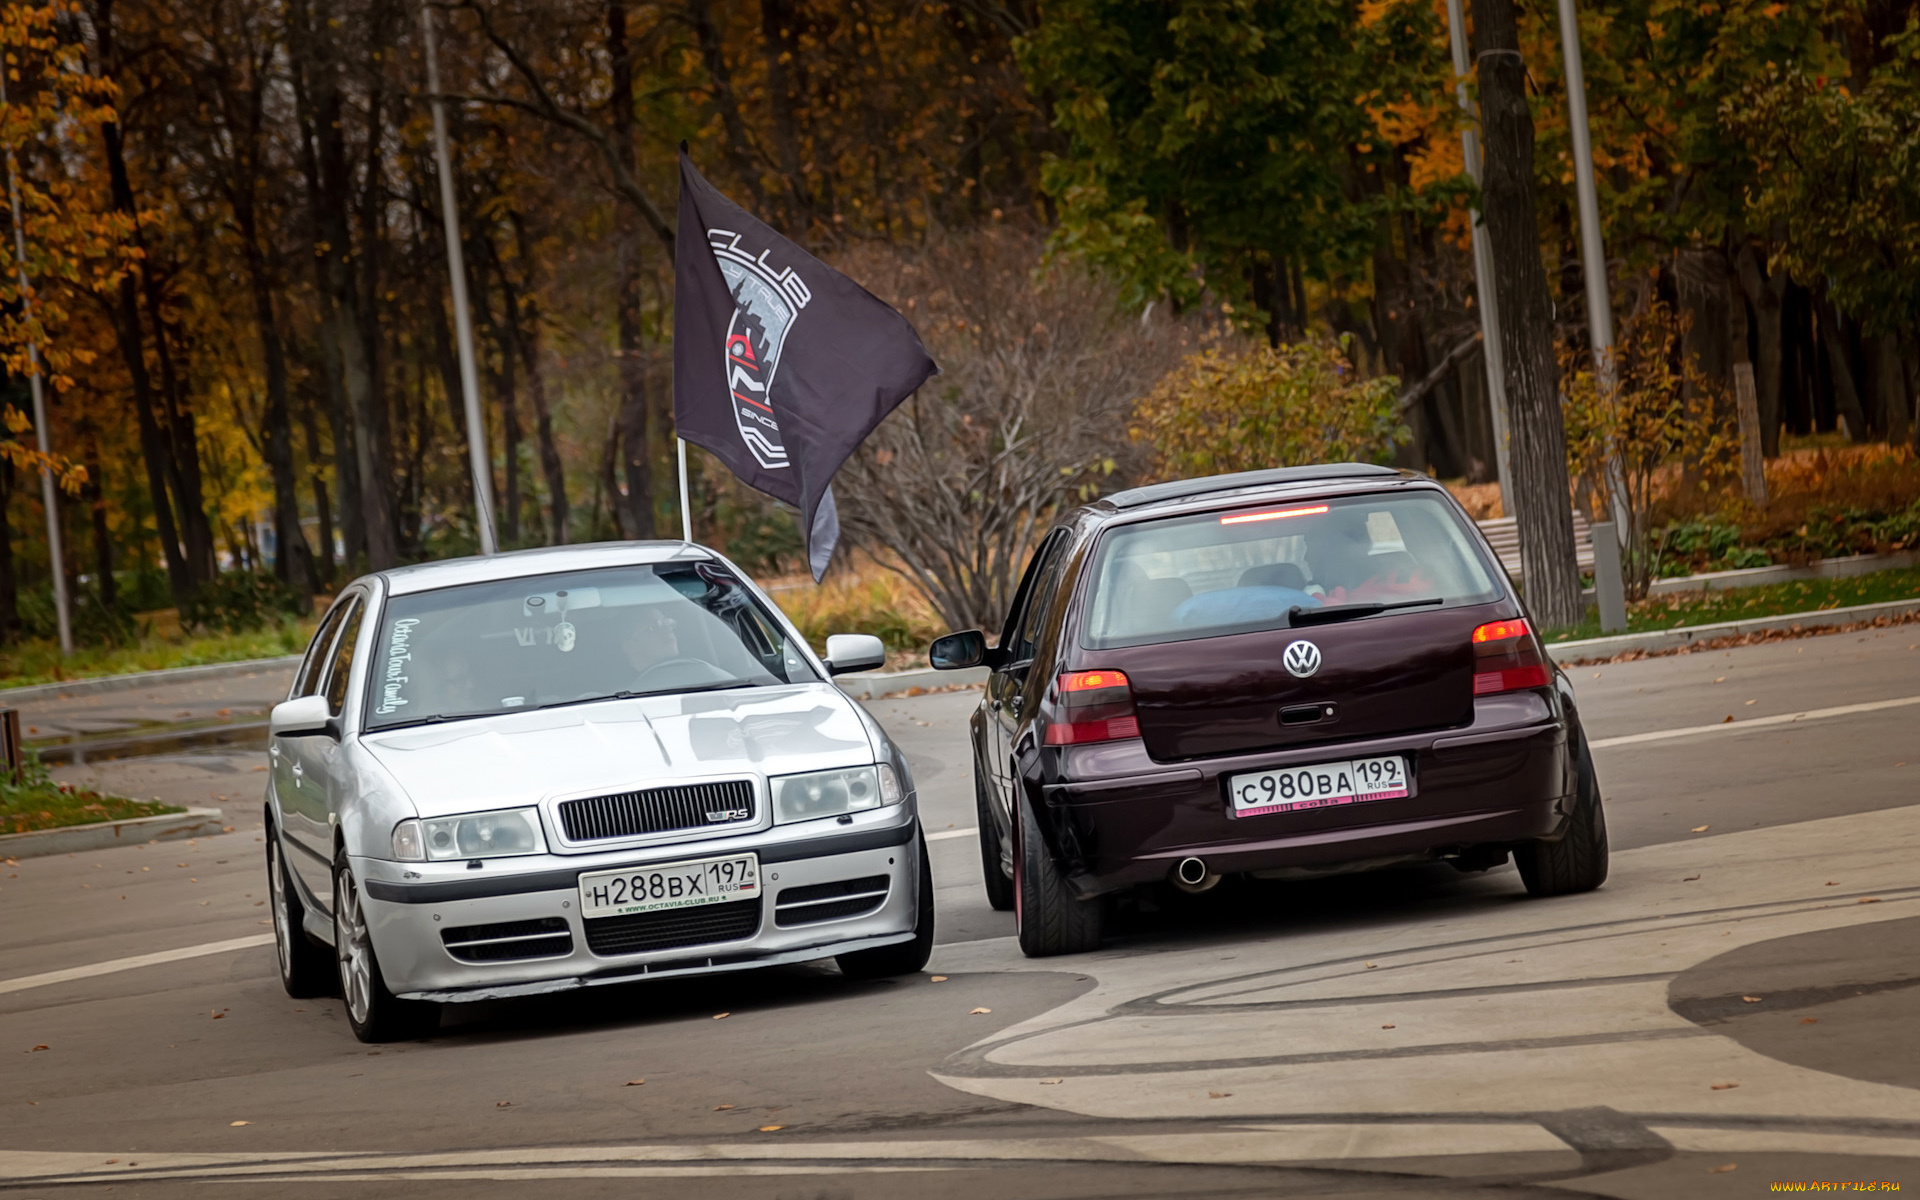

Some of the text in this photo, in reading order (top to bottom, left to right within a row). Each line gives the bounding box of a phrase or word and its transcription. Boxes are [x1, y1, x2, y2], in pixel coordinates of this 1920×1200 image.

[707, 228, 812, 309] CLUB
[748, 276, 789, 322] TRUE
[740, 407, 779, 431] SINCE
[1356, 760, 1397, 782] 199
[1367, 781, 1388, 790] RUS
[708, 860, 748, 884] 197
[718, 883, 739, 893] RUS
[625, 896, 720, 913] WWW.OCTAVIA-CLUB.RU
